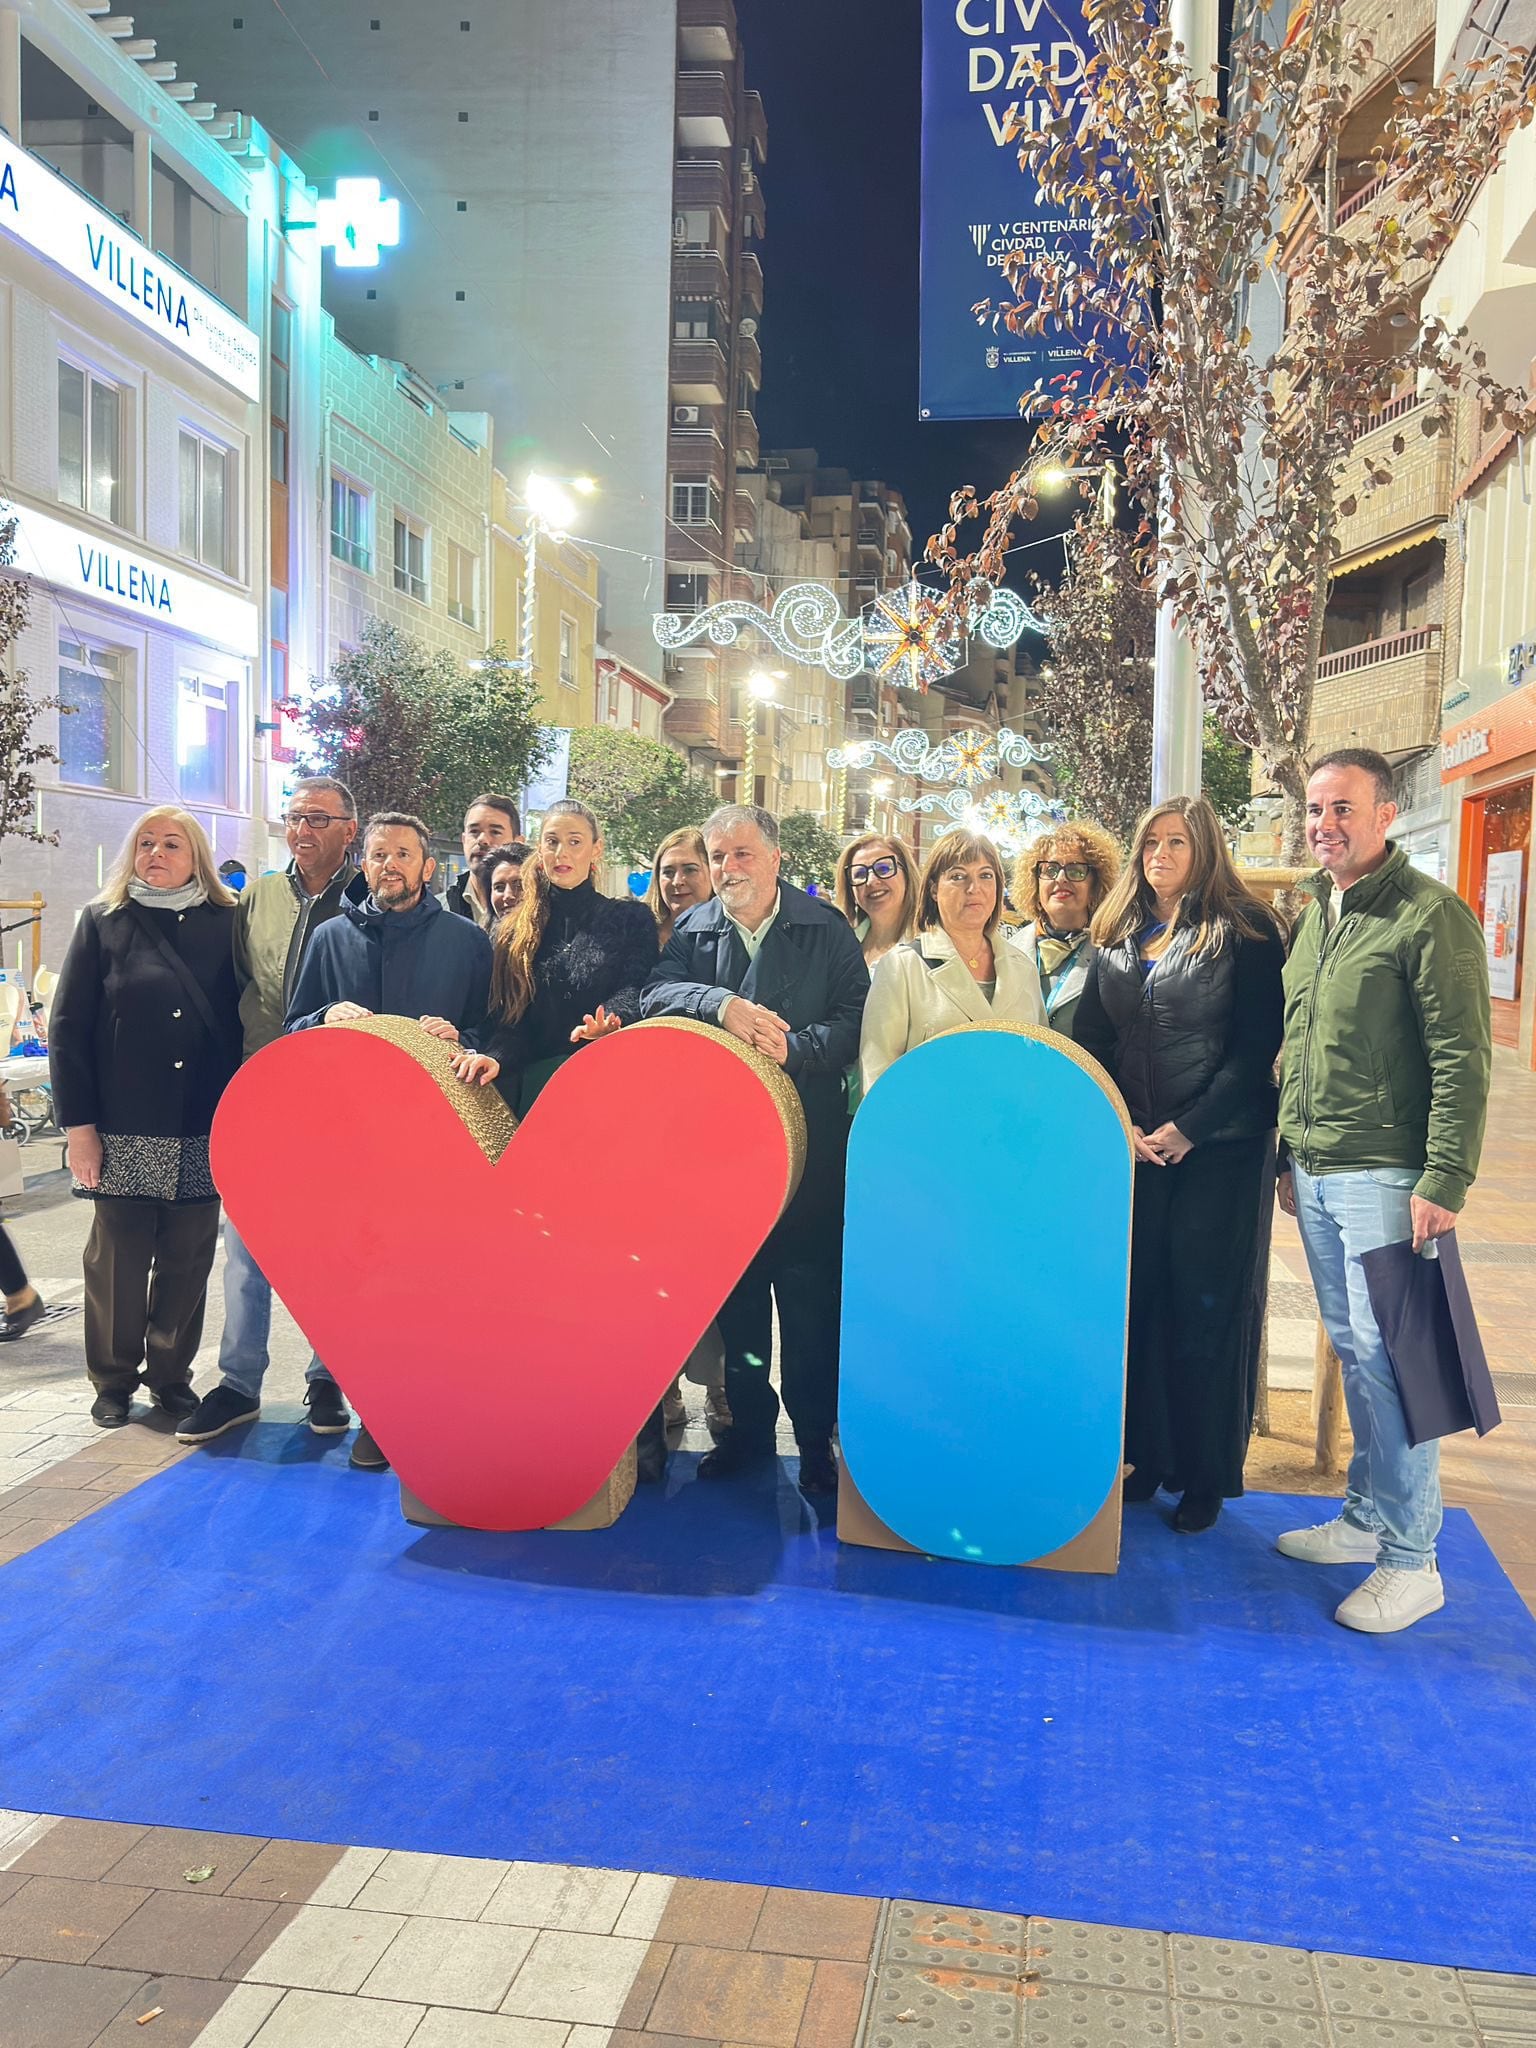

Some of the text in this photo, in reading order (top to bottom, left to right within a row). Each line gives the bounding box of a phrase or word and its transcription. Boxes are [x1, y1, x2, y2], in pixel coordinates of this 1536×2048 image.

[955, 0, 1043, 36] CIV
[968, 41, 1087, 92] DAD
[999, 223, 1010, 236] V
[991, 236, 1045, 252] CIVDAD
[1010, 250, 1065, 266] LLENA
[86, 223, 190, 337] VILLENA
[1003, 355, 1032, 363] VILLENA
[1047, 348, 1083, 358] VILLENA
[78, 543, 172, 613] VILLENA
